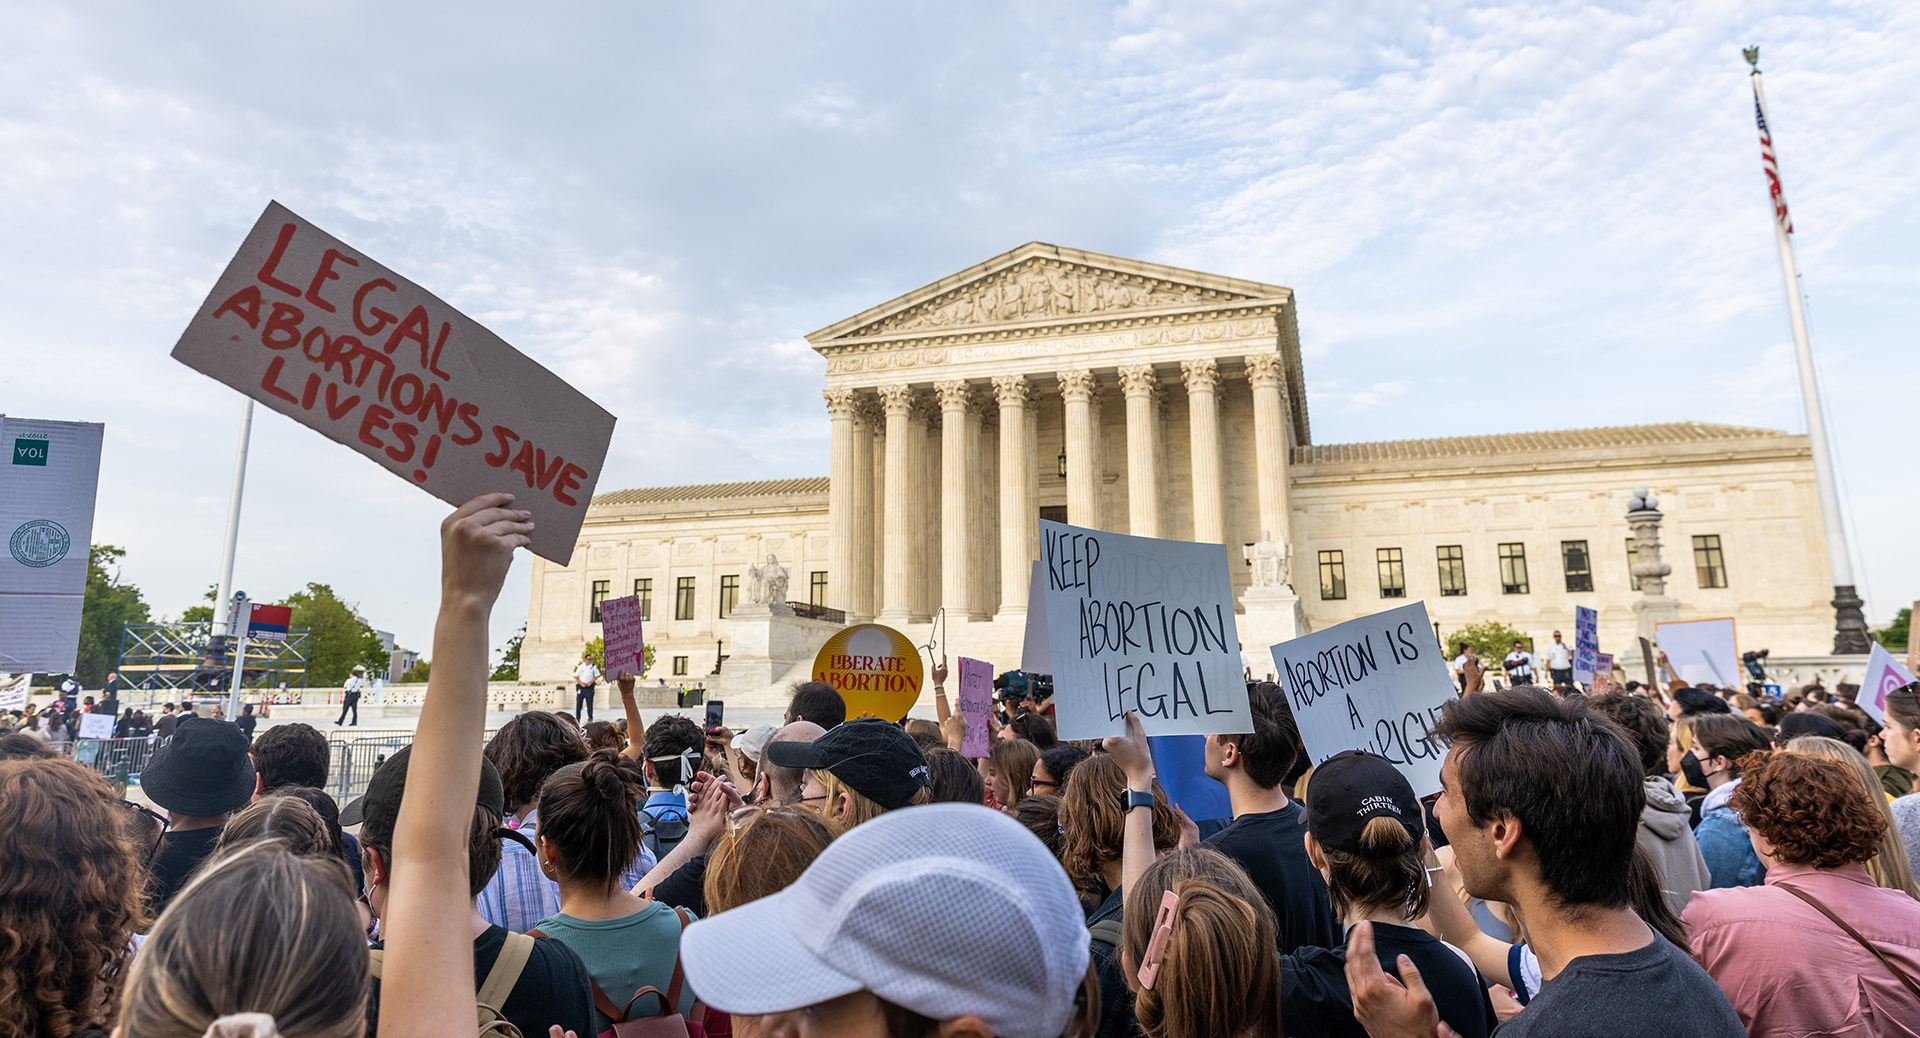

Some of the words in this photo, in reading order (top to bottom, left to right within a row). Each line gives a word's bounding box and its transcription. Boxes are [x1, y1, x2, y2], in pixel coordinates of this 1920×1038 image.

[257, 223, 450, 381] LEGAL
[1000, 342, 1049, 357] JUSTICE
[1055, 337, 1096, 351] UNDER
[1101, 335, 1126, 347] LAW
[213, 285, 482, 446] ABORTIONS
[485, 425, 587, 507] SAVE
[261, 355, 441, 483] LIVES!
[17, 447, 44, 458] 10A
[1045, 528, 1101, 598] KEEP
[231, 602, 241, 634] metrobus
[1079, 597, 1229, 659] ABORTION
[812, 671, 919, 693] ABORTION
[830, 654, 906, 672] LIBERATE
[1283, 634, 1378, 711] ABORTION
[1385, 622, 1419, 665] IS
[1104, 661, 1234, 722] LEGAL
[1345, 692, 1365, 731] A
[1356, 802, 1402, 817] THIRTEEN
[1361, 795, 1393, 806] CABIN
